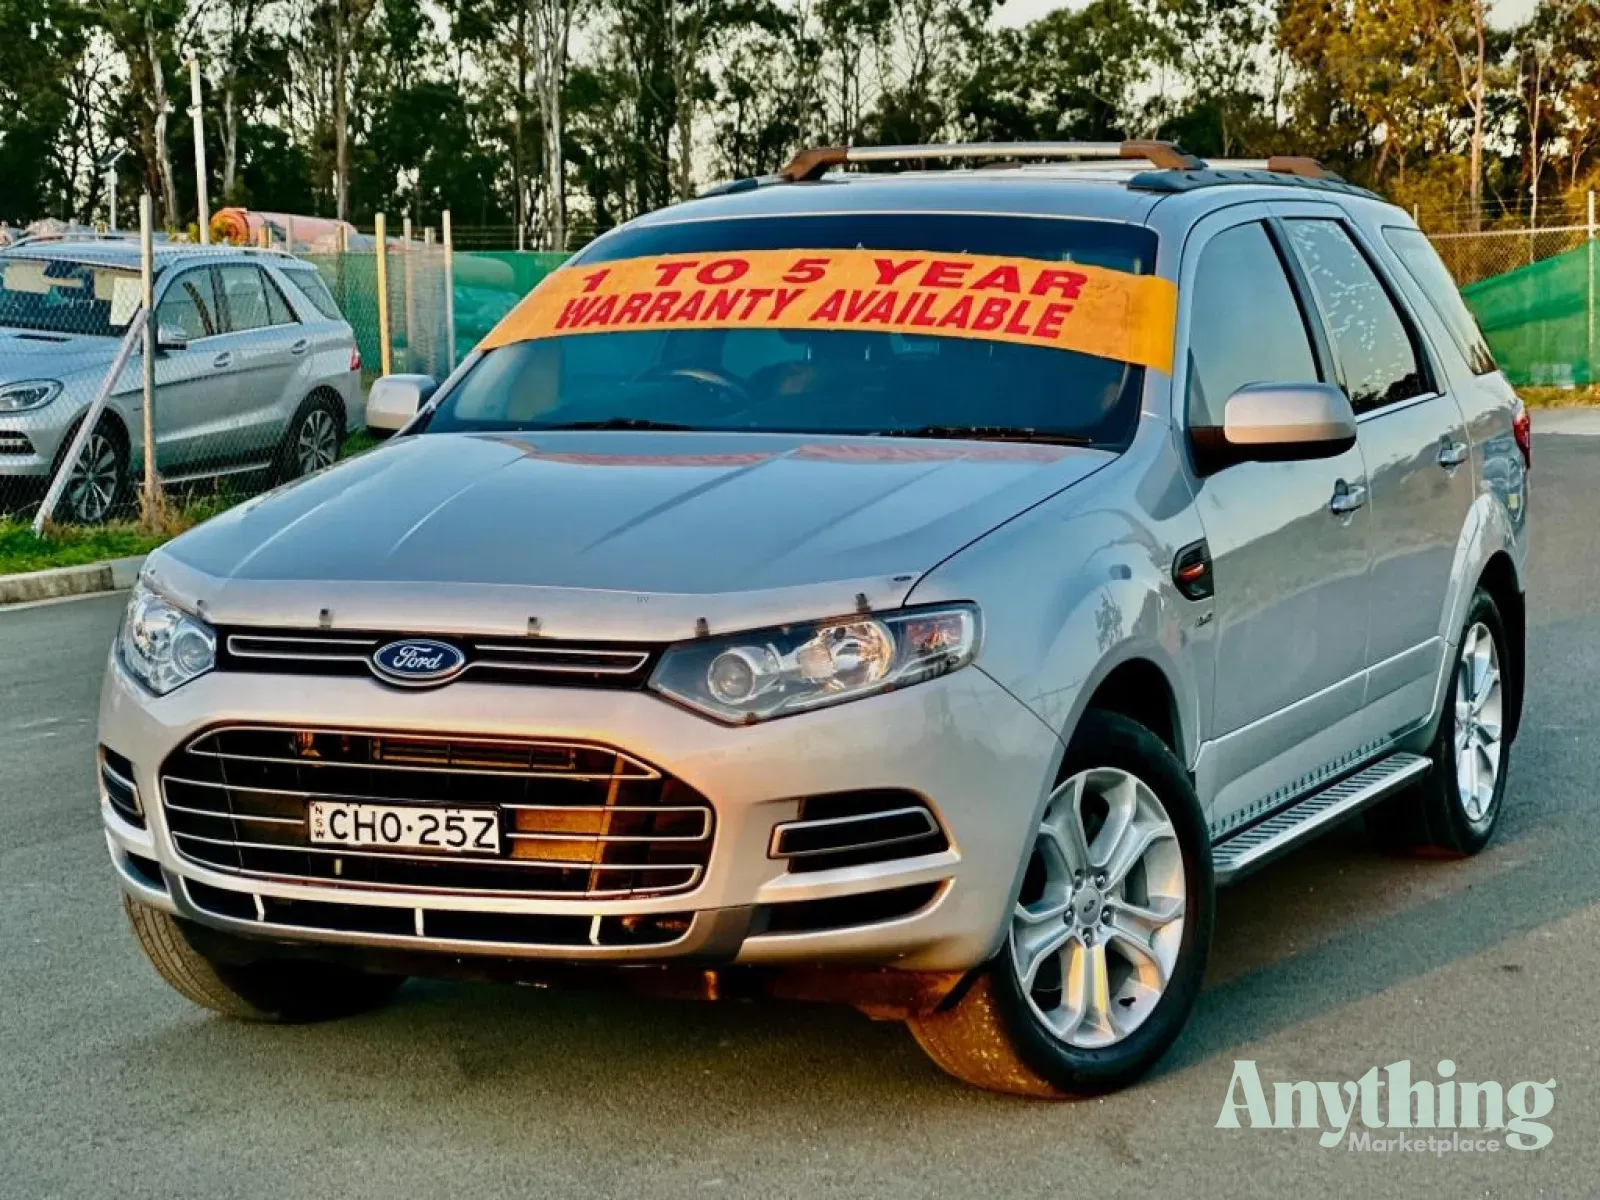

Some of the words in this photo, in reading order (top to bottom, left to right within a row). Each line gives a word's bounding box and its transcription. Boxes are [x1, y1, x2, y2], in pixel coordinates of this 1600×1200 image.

[582, 268, 612, 292] 1
[655, 260, 750, 287] TO
[782, 258, 831, 283] 5
[874, 258, 1088, 300] YEAR
[554, 288, 806, 330] WARRANTY
[808, 288, 1074, 340] AVAILABLE
[392, 645, 444, 670] Ford
